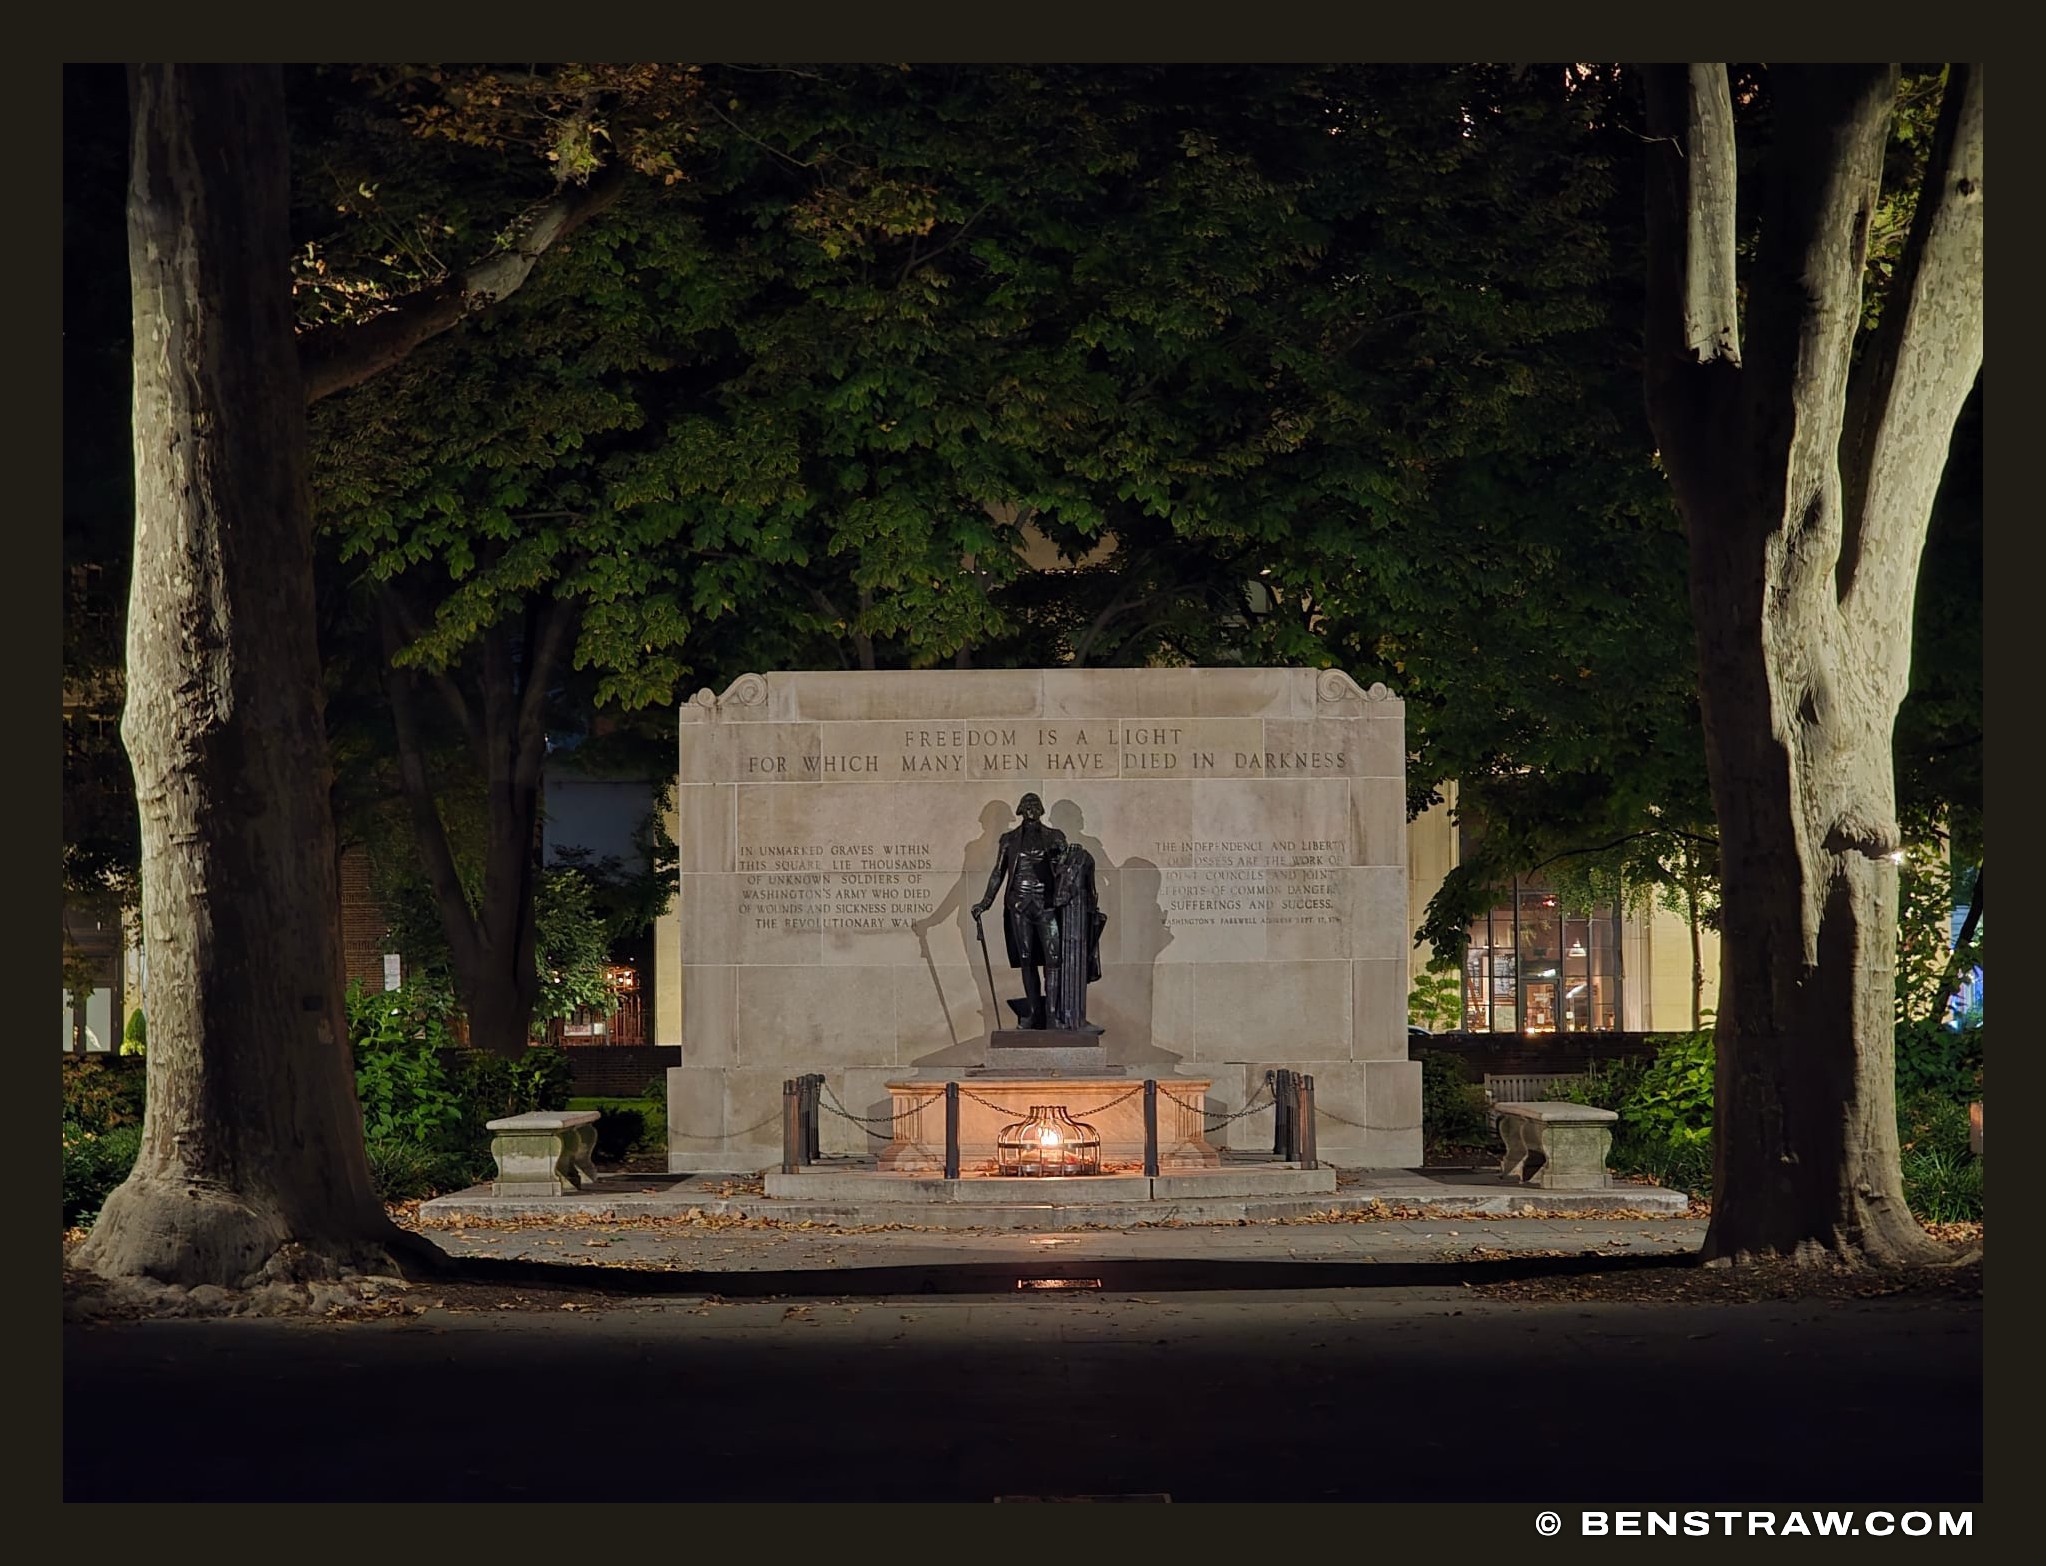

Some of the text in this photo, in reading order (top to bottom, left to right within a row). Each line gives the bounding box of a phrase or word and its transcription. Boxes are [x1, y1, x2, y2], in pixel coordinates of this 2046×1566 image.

[905, 729, 1182, 747] FREEDOM IS A LIGHT
[749, 752, 1346, 773] FOR WHICH MANY MEN HAVE DIED IN DARKNESS
[740, 843, 930, 856] IN UNMARKED GRAVES WITHIN
[1155, 842, 1176, 853] THE
[1272, 841, 1296, 851] AND
[739, 859, 932, 872] THIS SQUARE LIE THOUSANDS
[1237, 856, 1258, 867] ARE
[1264, 856, 1287, 866] THE
[1292, 856, 1323, 866] WORK
[747, 874, 923, 885] OF UNKNOWN SOLDIERS OF
[1206, 870, 1264, 881] COUNCILS
[1272, 870, 1297, 880] AND
[1302, 870, 1336, 882] JOINT
[835, 889, 867, 899] ARMY
[872, 888, 900, 899] WHO
[903, 888, 931, 899] DIED
[738, 903, 934, 914] OF WOUNDS AND SICKNESS DURING
[1171, 900, 1242, 910] SUFFERINGS
[1249, 900, 1275, 910] AND
[755, 917, 917, 929] THE REVOLUTIONARY WAR
